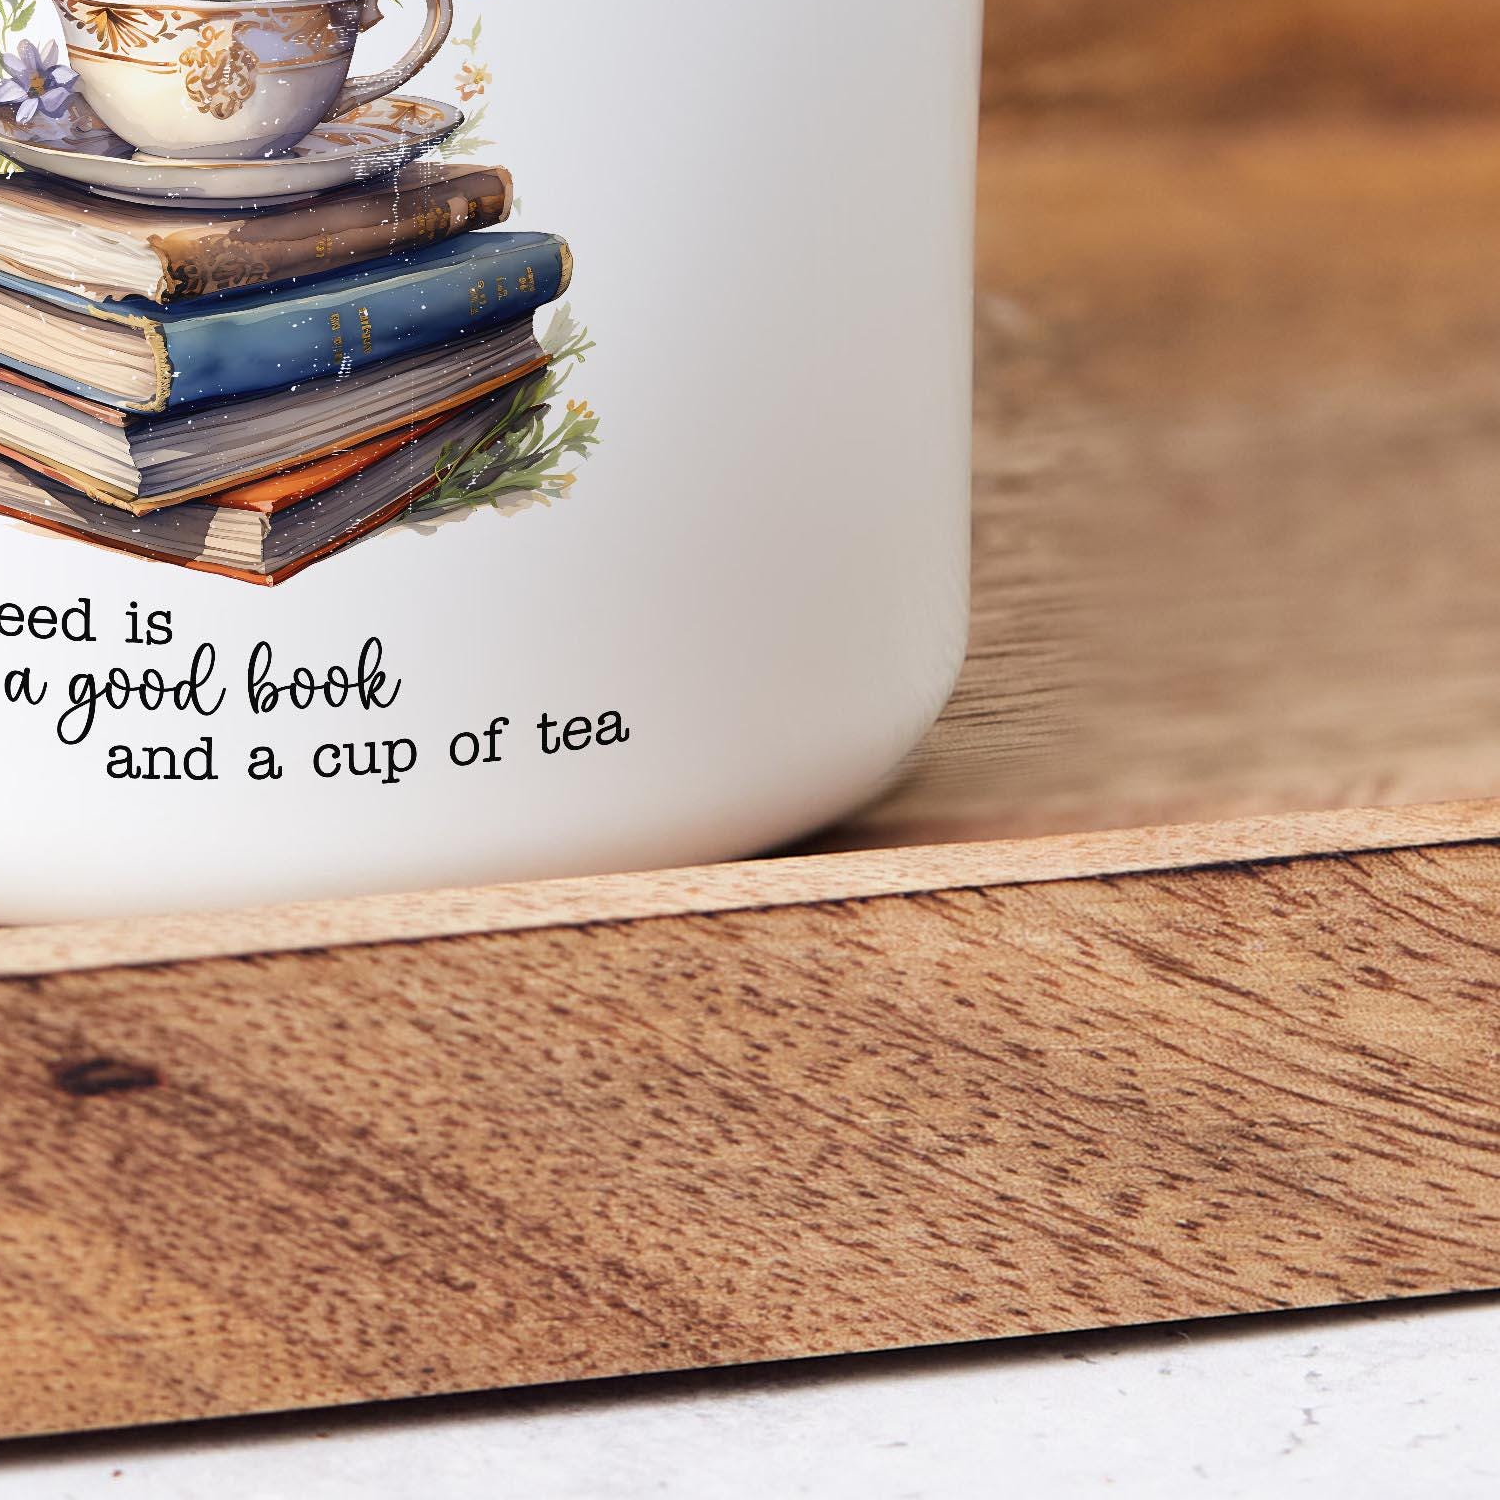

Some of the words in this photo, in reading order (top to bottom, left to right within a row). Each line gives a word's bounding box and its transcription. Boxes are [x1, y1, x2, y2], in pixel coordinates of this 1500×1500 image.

[124, 600, 173, 646] is
[4, 666, 48, 706] a
[56, 642, 227, 746] good
[247, 636, 402, 715] book
[106, 736, 219, 781] and
[247, 746, 283, 781] a
[312, 738, 418, 785] cup
[449, 717, 510, 767] of
[536, 710, 630, 755] tea
